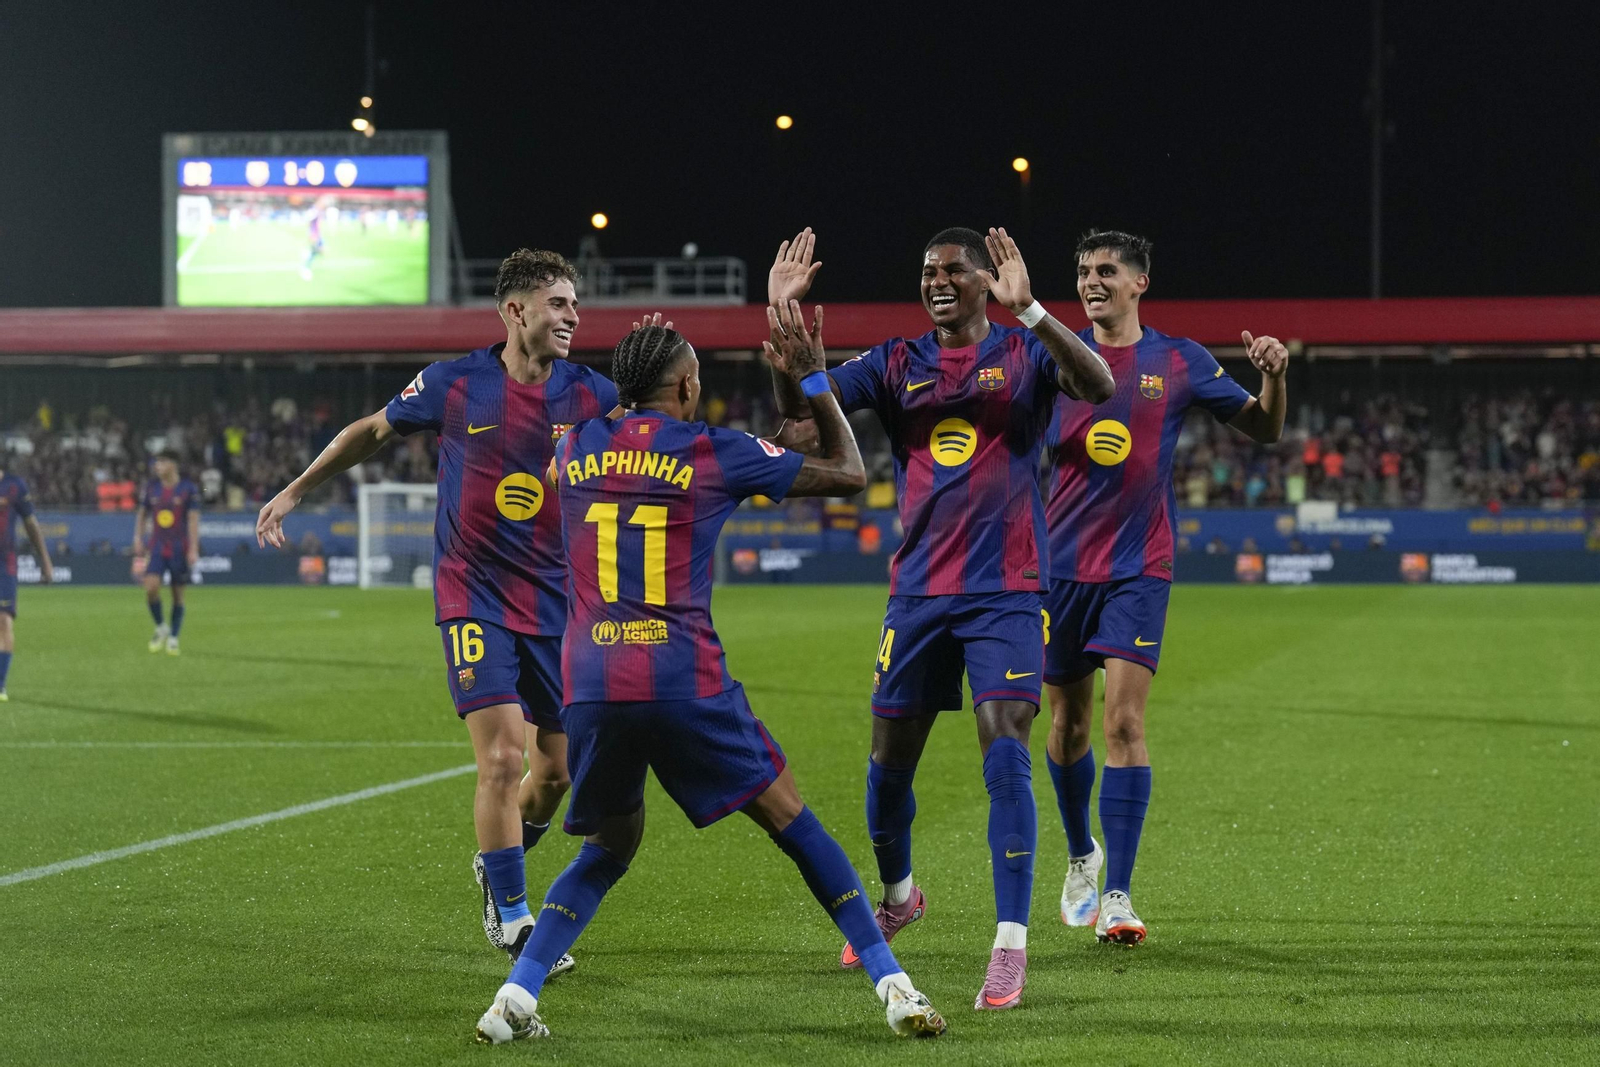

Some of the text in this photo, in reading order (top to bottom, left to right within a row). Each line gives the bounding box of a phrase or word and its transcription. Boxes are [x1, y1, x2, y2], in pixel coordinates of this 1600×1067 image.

[566, 450, 694, 490] RAPHINHA
[584, 503, 668, 606] 11
[448, 622, 485, 667] 16
[622, 619, 668, 631] UNHCR
[623, 629, 669, 641] ACNUR
